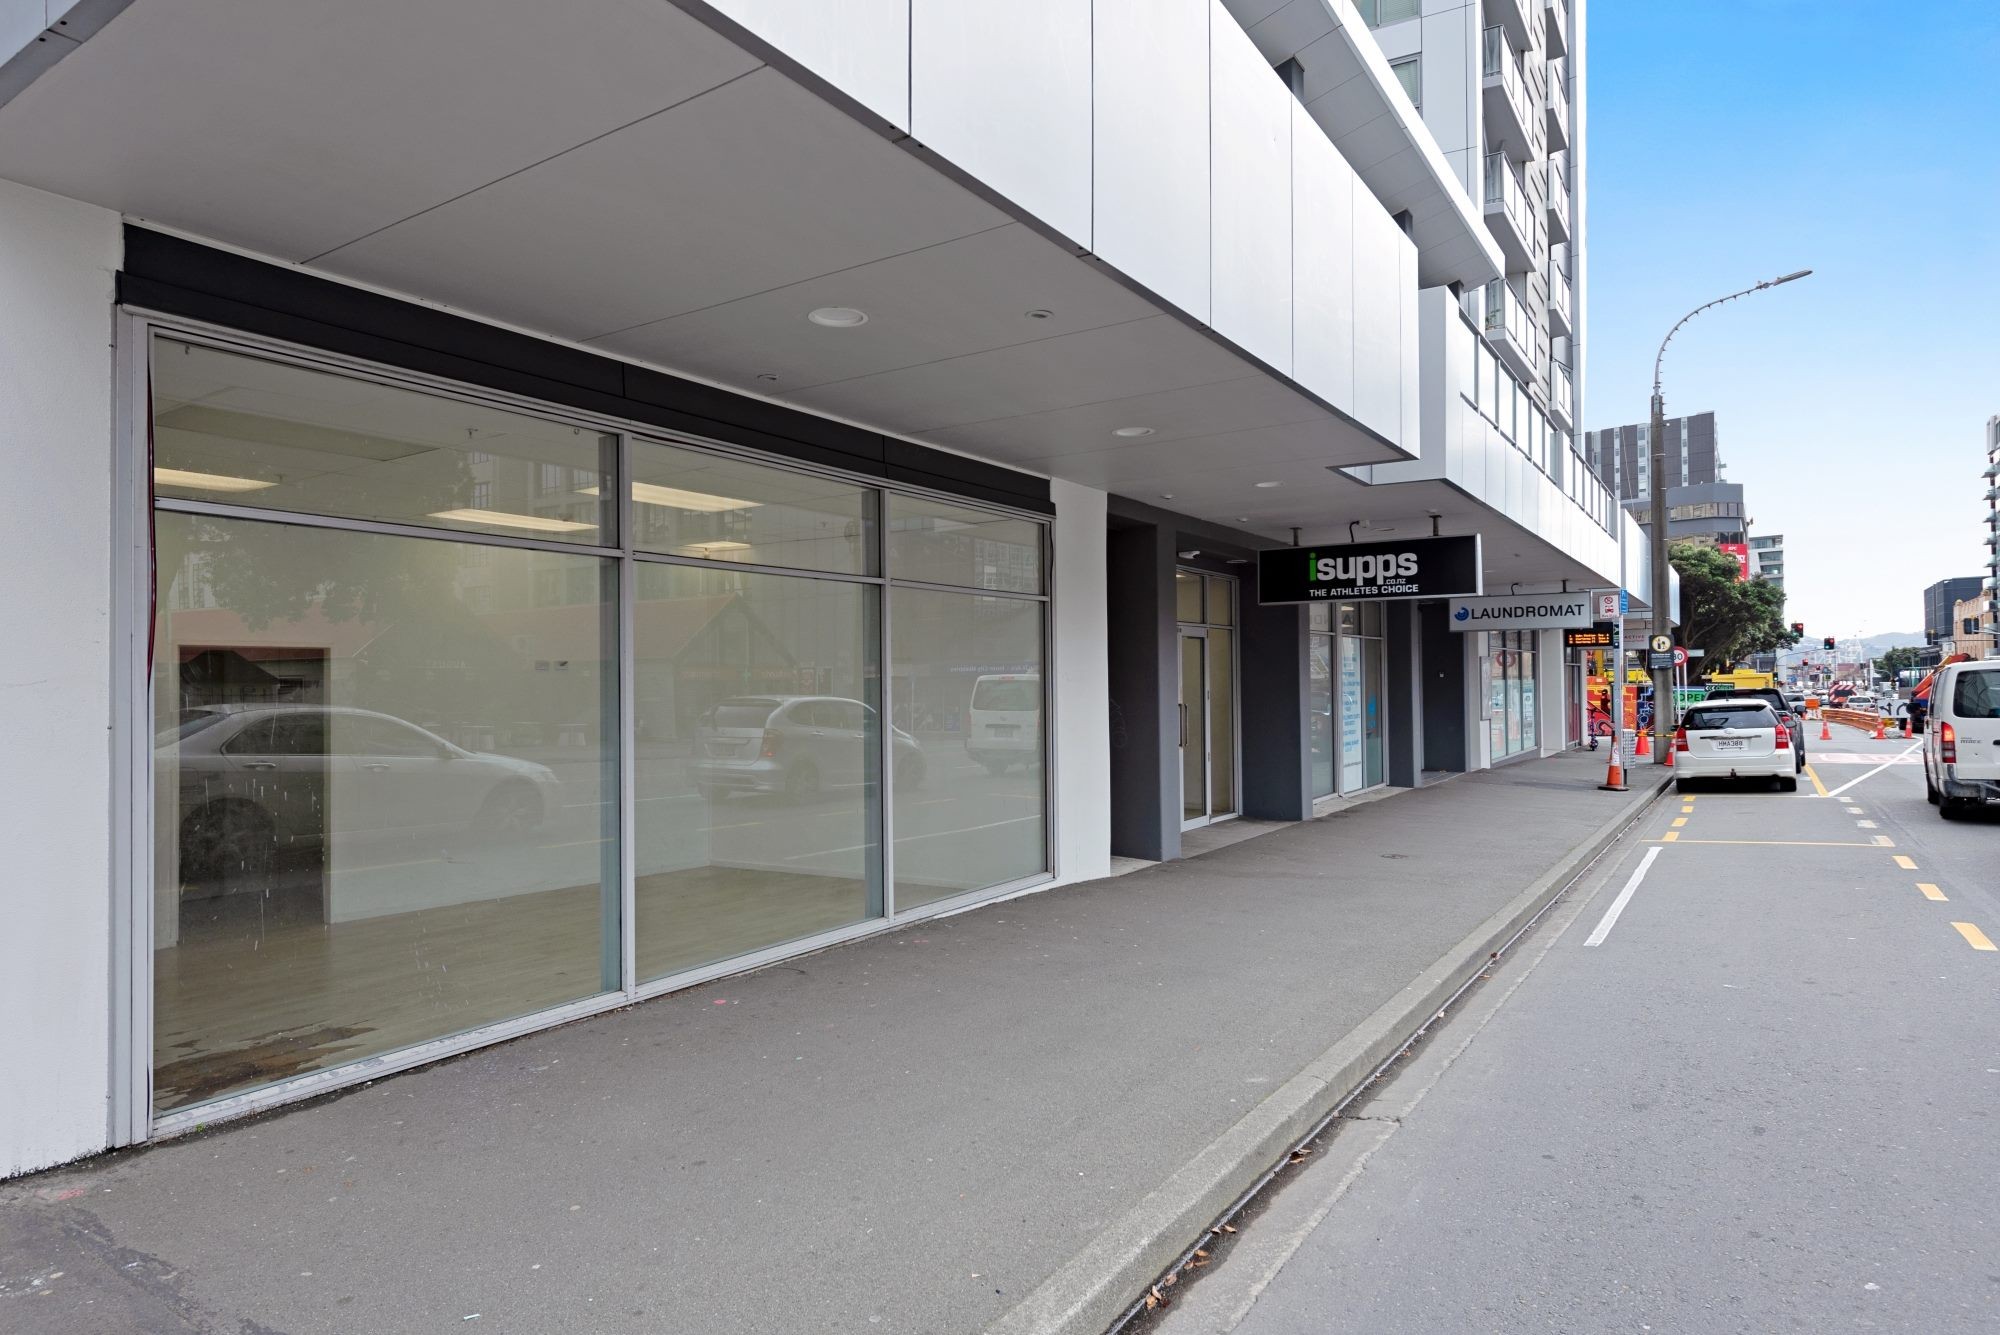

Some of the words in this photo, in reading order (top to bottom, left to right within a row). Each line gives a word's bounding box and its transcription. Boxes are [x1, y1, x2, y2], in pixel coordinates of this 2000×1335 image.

[1309, 552, 1419, 586] isupps
[1309, 588, 1328, 597] THE
[1330, 586, 1378, 596] ATHLETES
[1381, 584, 1419, 594] CHOICE
[1471, 604, 1585, 620] LAUNDROMAT
